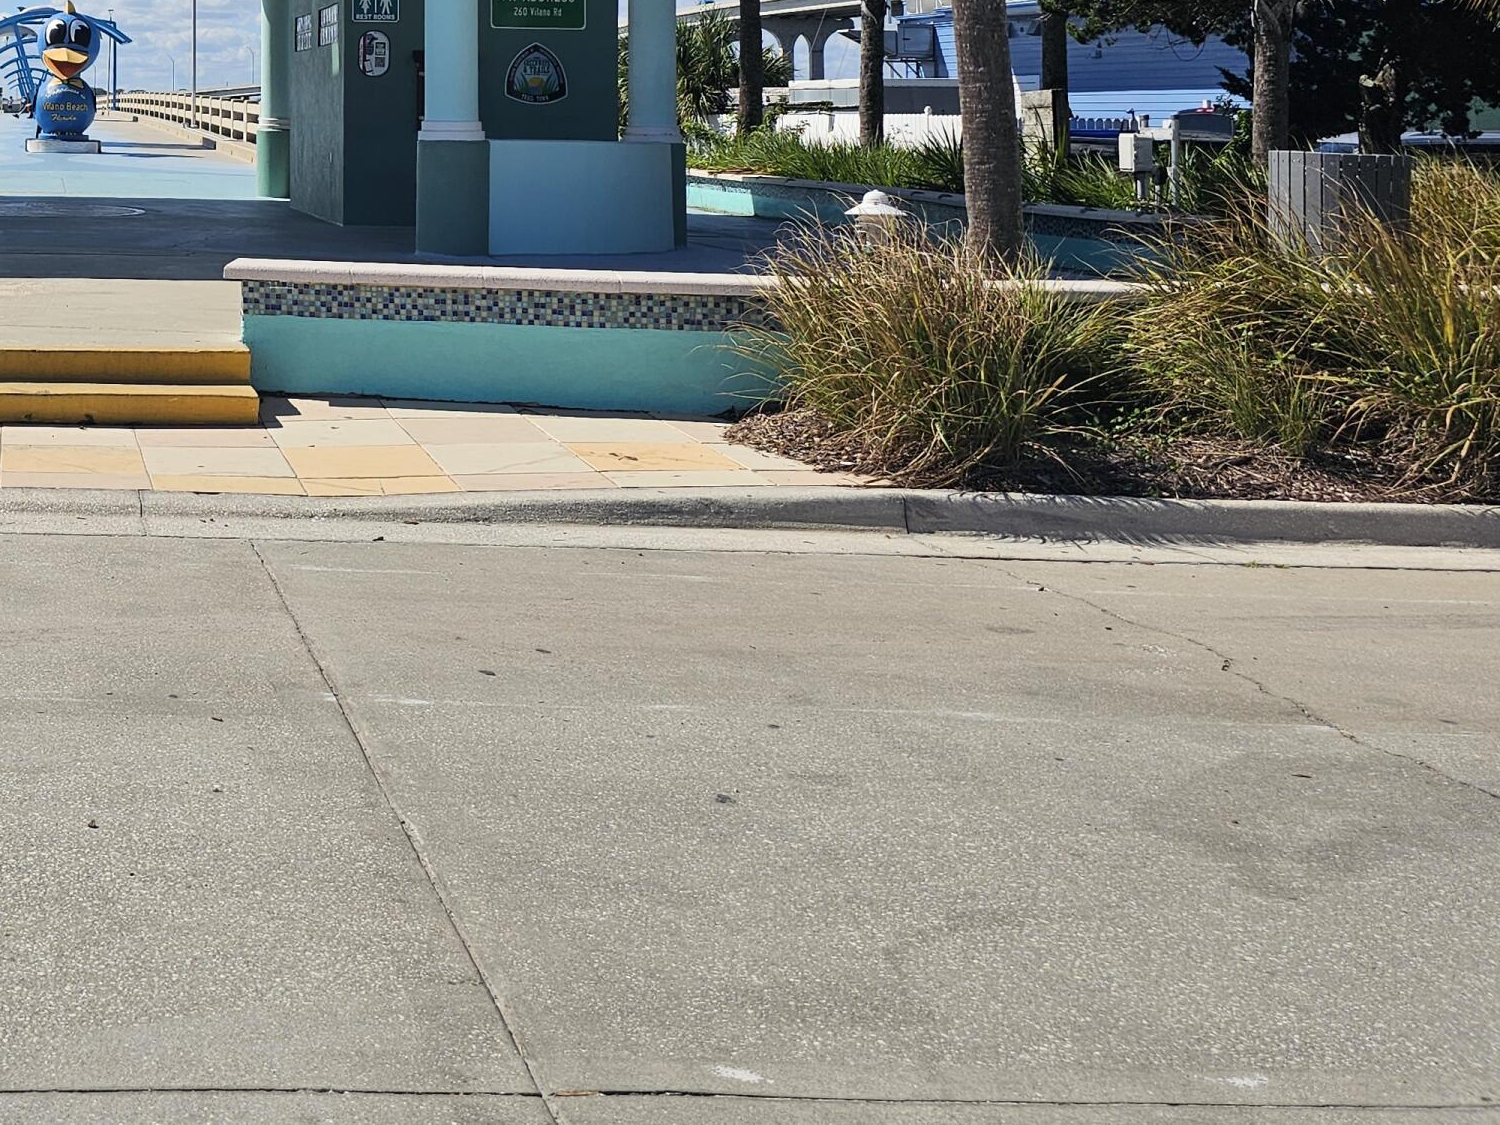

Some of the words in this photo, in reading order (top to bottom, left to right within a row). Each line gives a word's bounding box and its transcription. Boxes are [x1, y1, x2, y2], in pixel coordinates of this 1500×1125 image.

[513, 6, 529, 16] 260
[530, 6, 551, 17] Vilano
[553, 7, 563, 17] Rd
[66, 102, 88, 111] Beach
